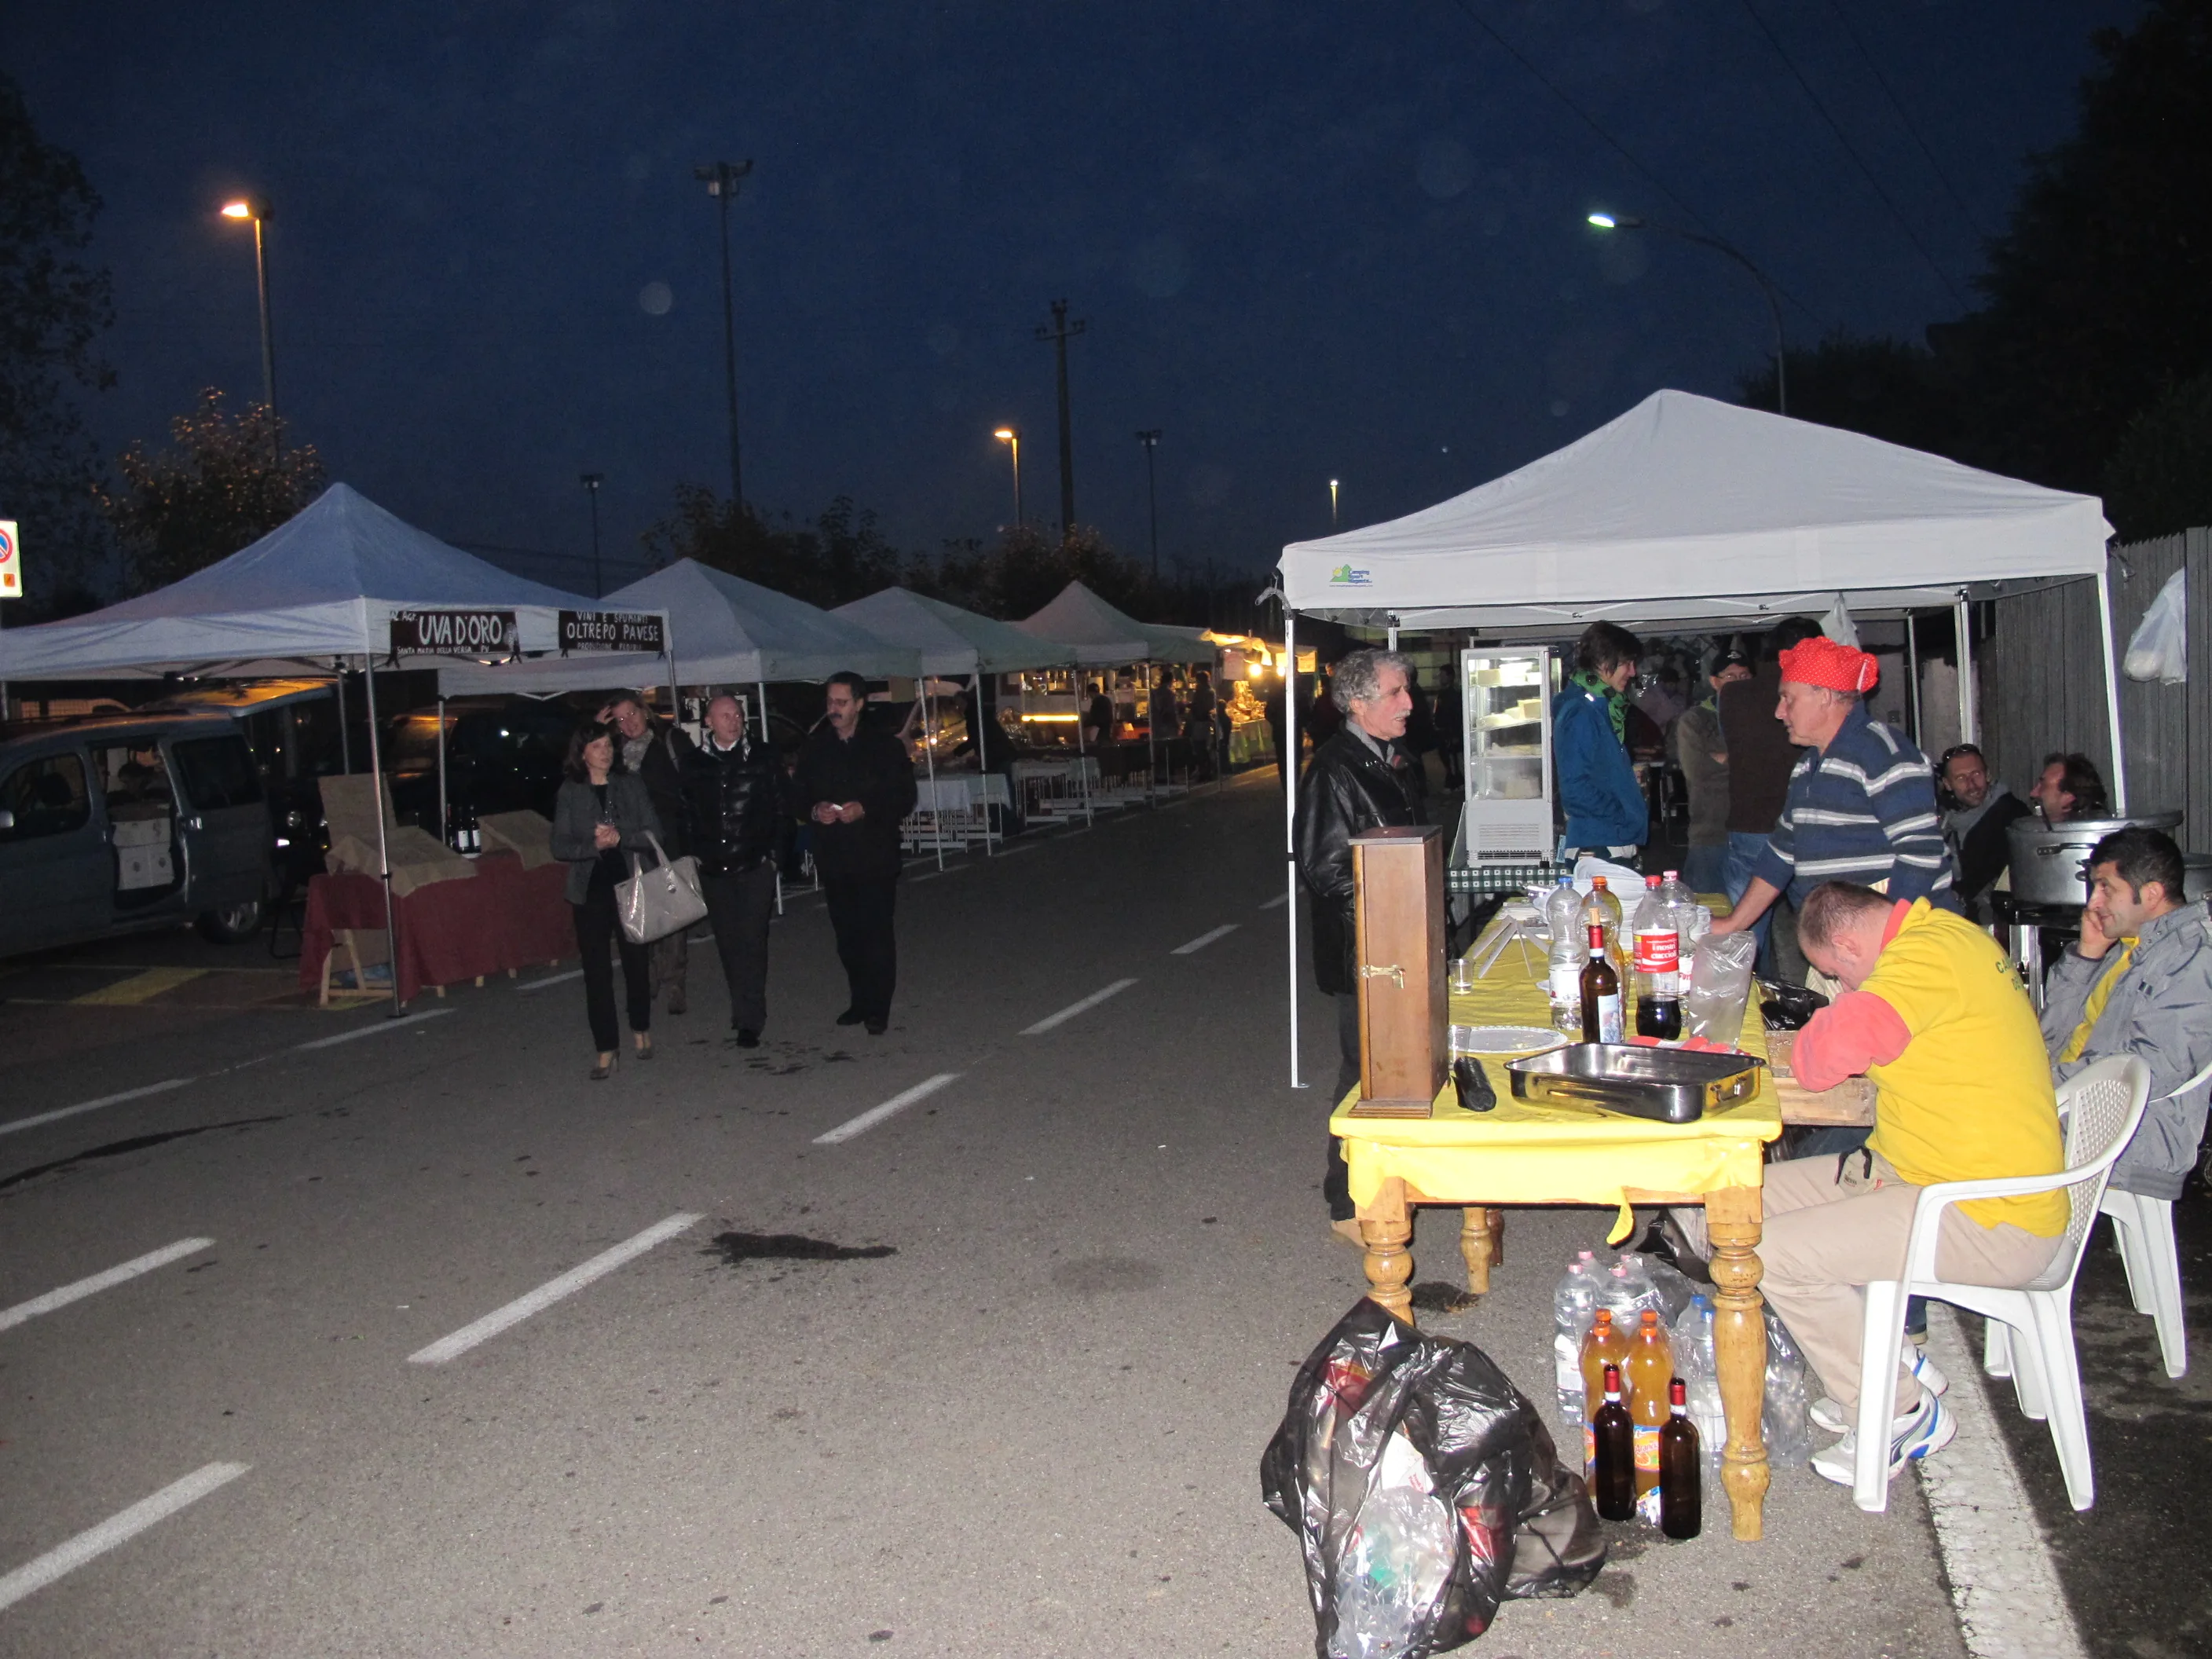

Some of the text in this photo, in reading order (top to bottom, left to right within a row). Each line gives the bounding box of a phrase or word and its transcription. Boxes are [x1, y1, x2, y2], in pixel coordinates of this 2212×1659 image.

[577, 611, 596, 621] VINI
[602, 613, 607, 623] E
[419, 614, 452, 646] UVA
[623, 624, 659, 642] PAVESE
